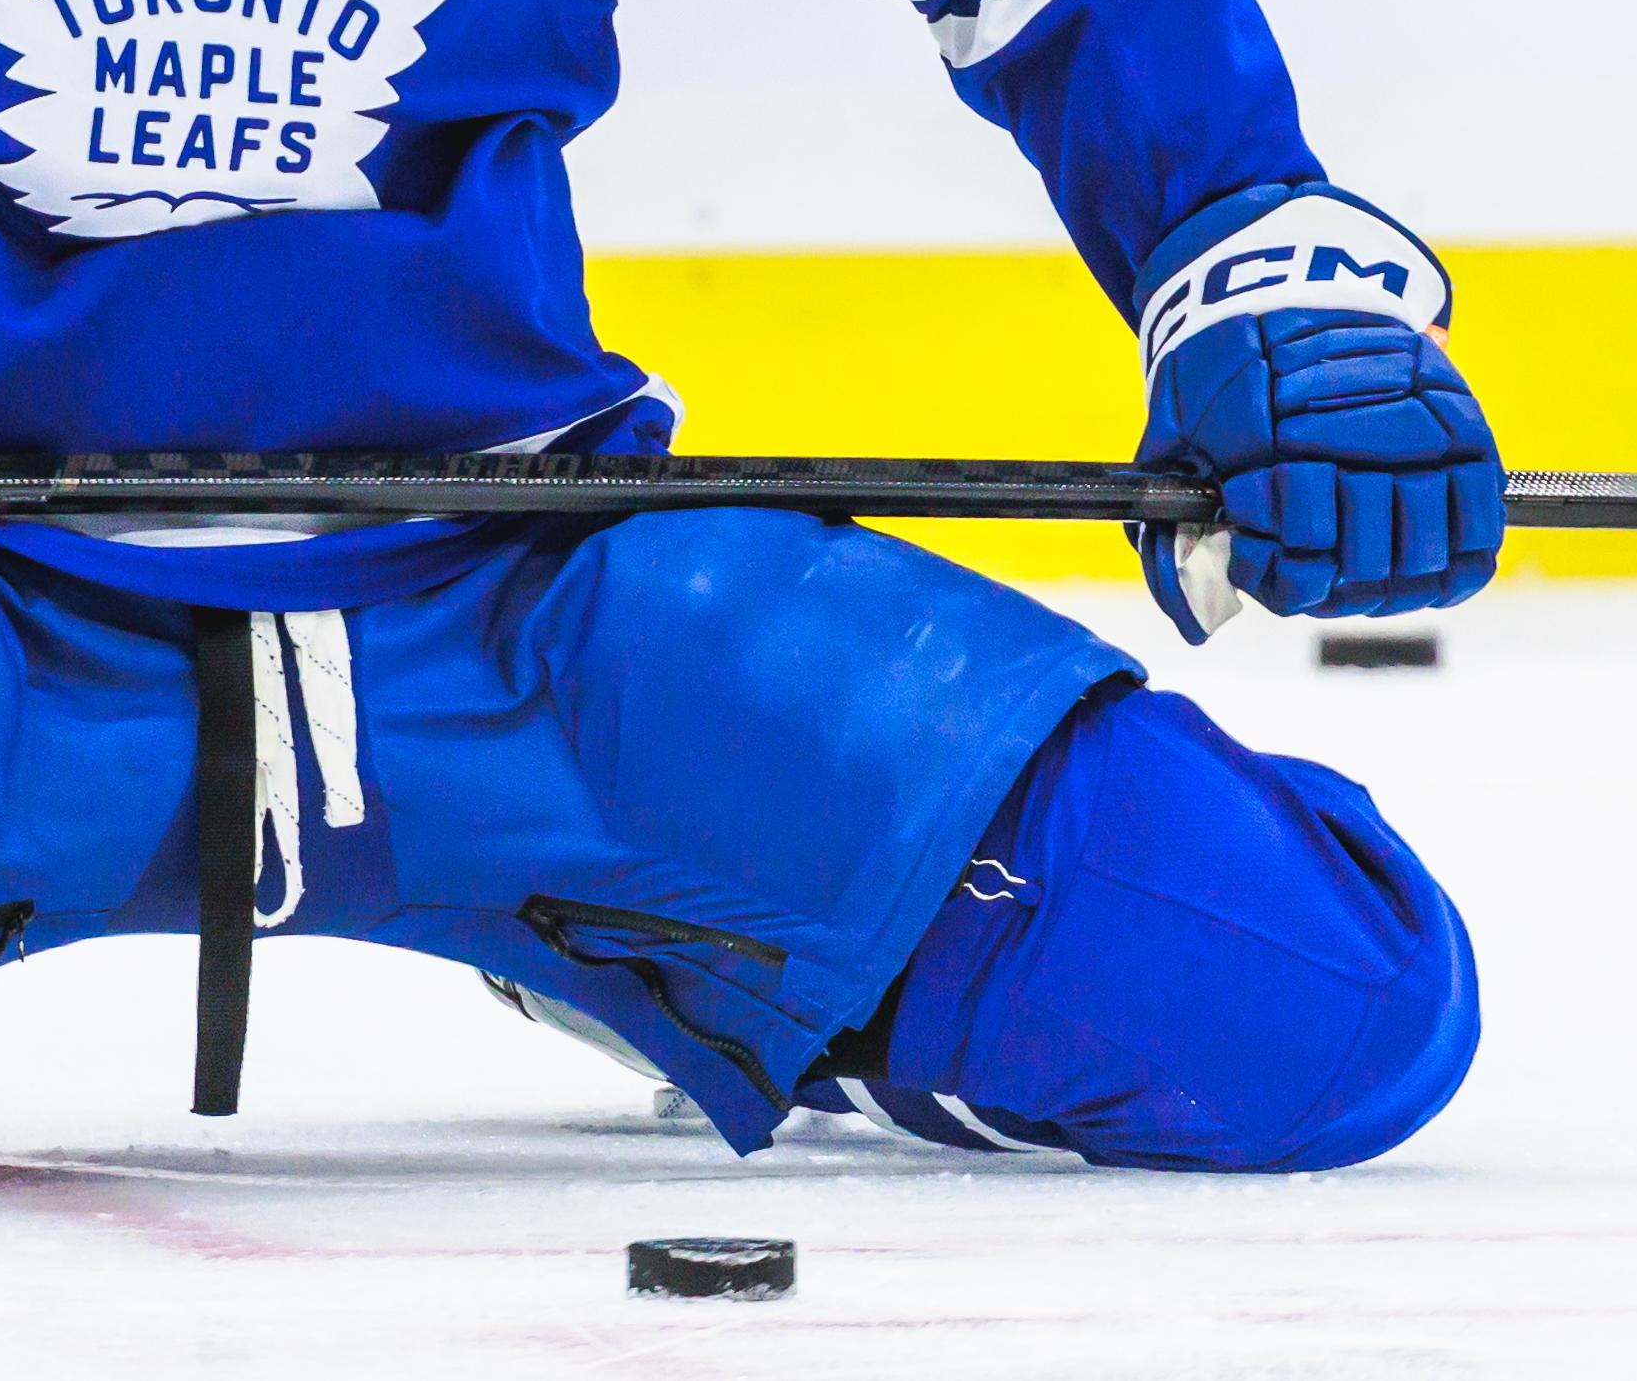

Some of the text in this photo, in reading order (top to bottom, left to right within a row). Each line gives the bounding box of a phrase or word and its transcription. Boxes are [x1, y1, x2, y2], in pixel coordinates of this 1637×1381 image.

[95, 36, 325, 107] MAPLE
[88, 107, 316, 174] LEAFS
[1147, 244, 1410, 377] CCM
